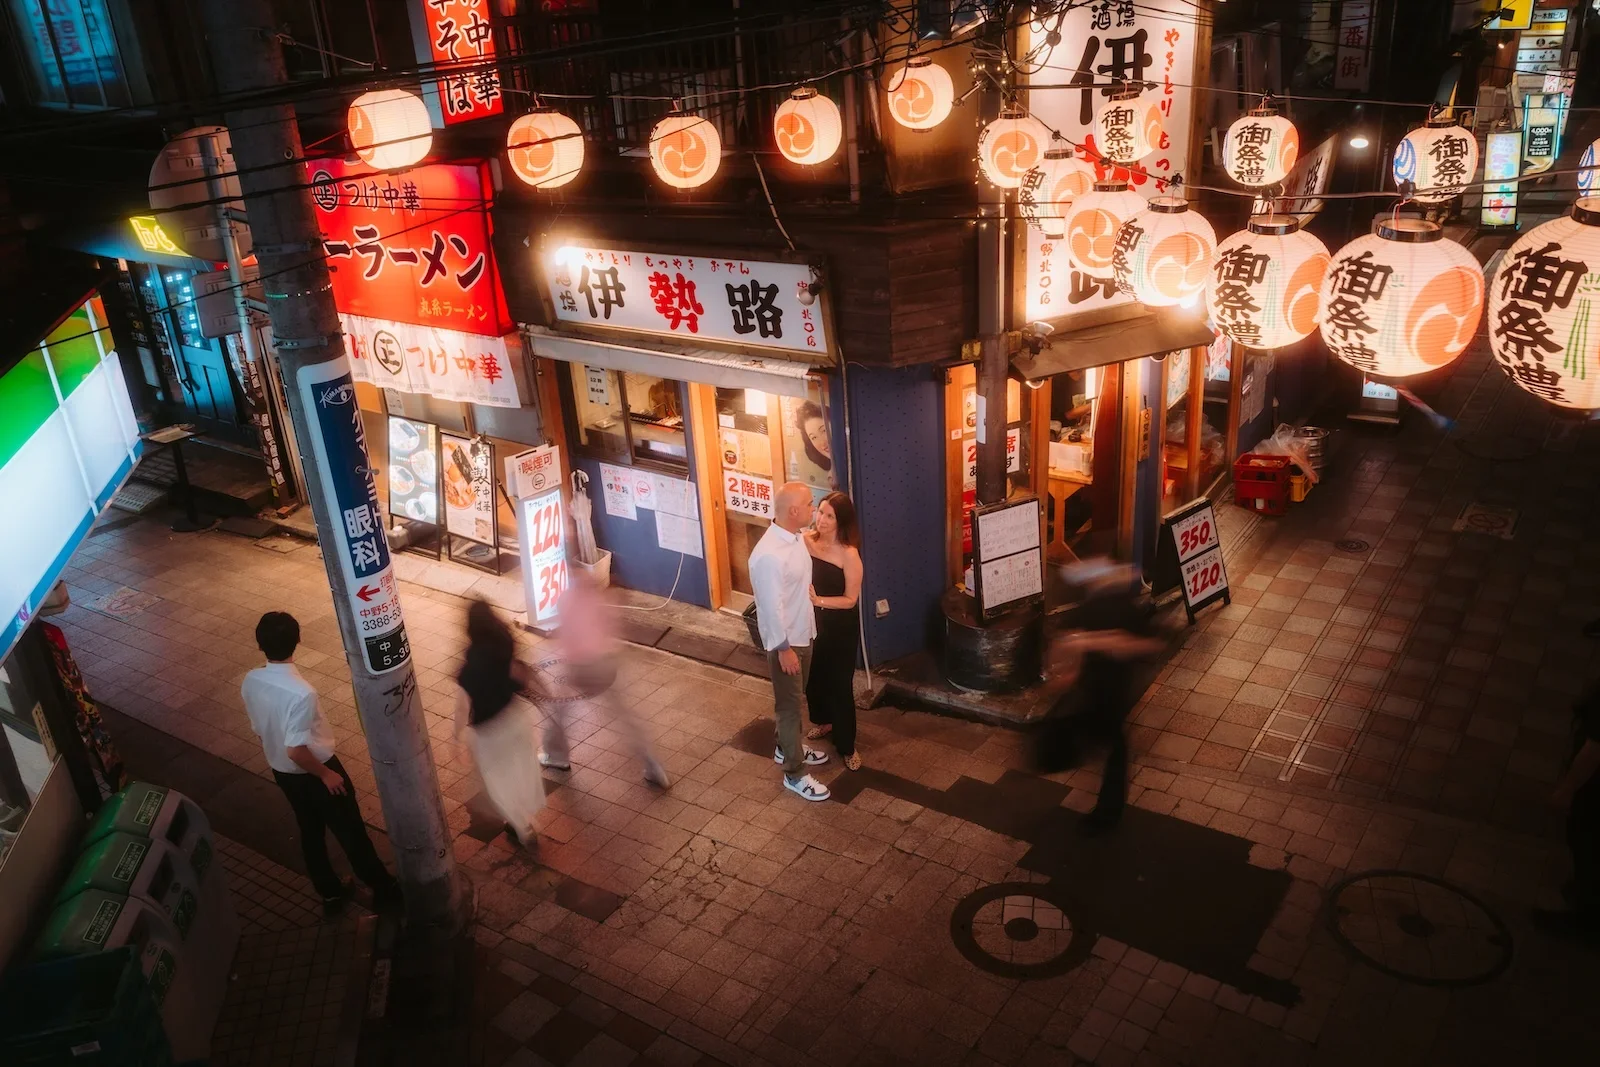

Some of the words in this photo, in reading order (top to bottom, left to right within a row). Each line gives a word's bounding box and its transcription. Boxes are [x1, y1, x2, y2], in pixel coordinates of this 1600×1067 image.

[429, 0, 474, 114] そば
[459, 0, 501, 109] 中華
[1161, 28, 1180, 117] やきとり
[344, 180, 421, 216] つけ中華
[585, 251, 631, 266] やきとり
[644, 255, 694, 271] もつやき
[710, 259, 750, 275] おでん
[578, 265, 784, 339] 伊勢路
[797, 280, 817, 347] 中北口店
[406, 346, 503, 386] つけ中華
[521, 452, 552, 474] 喫煙可
[728, 477, 771, 501] 2階席
[731, 495, 771, 514] あります
[344, 504, 380, 571] 眼科
[532, 501, 561, 557] 120
[1180, 521, 1211, 556] 350
[539, 559, 567, 612] 350
[1191, 562, 1220, 599] 120
